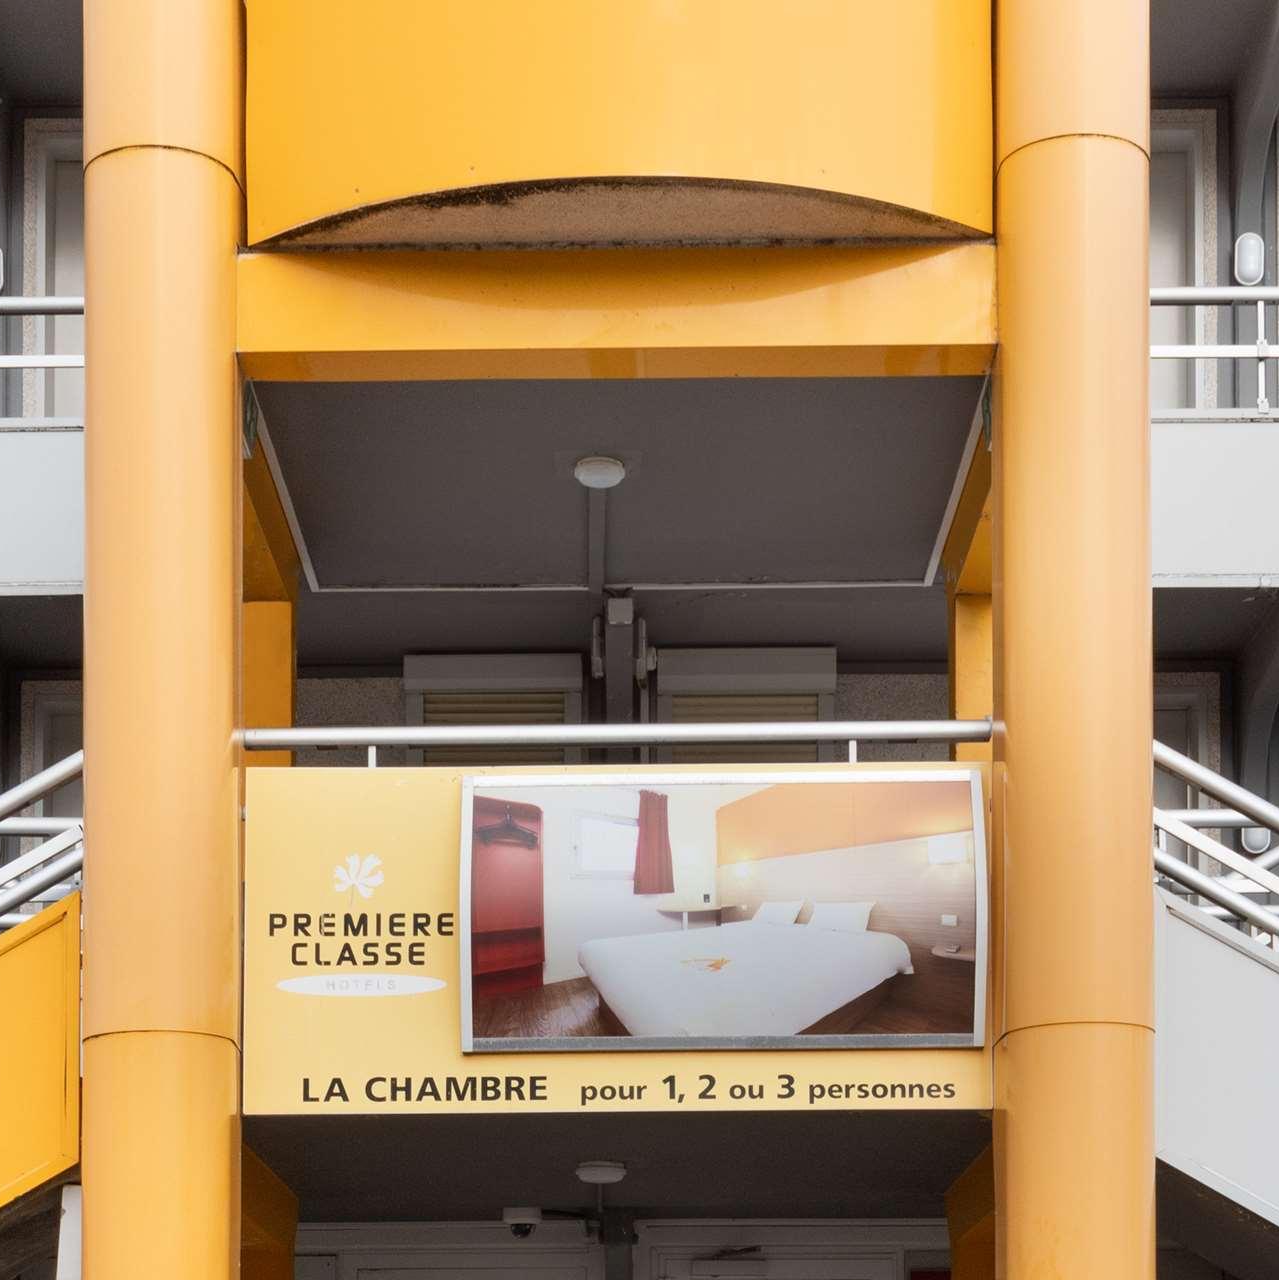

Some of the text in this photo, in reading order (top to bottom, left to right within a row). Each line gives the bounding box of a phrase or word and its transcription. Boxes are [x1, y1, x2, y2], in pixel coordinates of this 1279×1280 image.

[268, 912, 454, 937] PREMIERE
[291, 942, 426, 966] CLASSE
[302, 1073, 955, 1105] LA CHAMBRE pour 1, 2 ou 3 personnes
